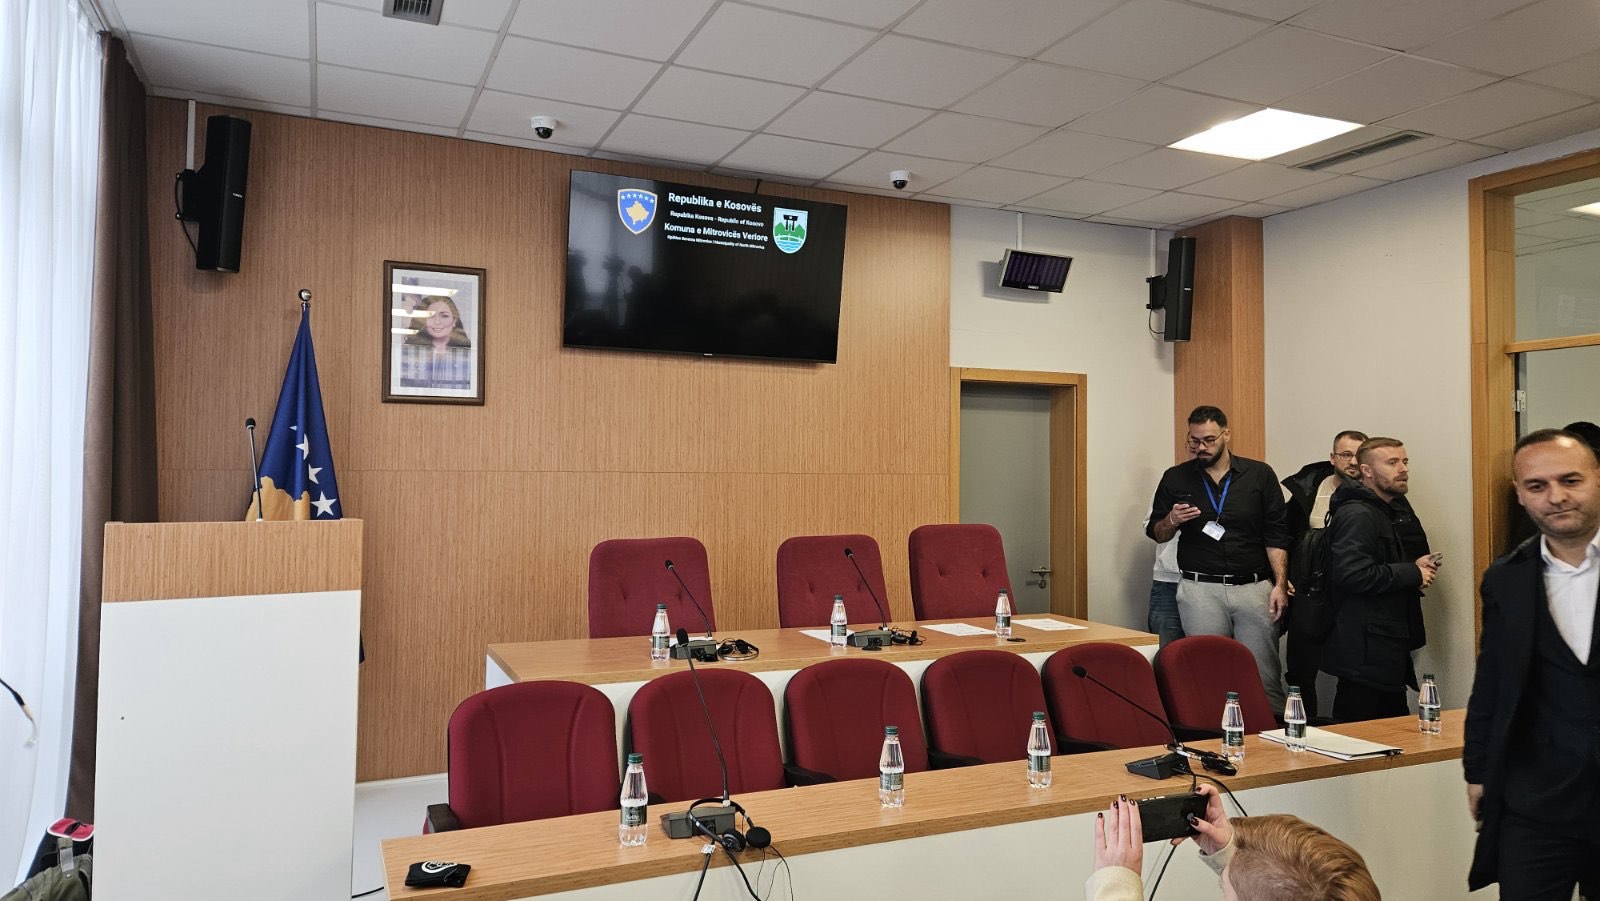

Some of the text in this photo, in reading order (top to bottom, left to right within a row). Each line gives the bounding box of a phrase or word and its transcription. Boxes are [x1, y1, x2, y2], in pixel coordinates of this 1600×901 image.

[668, 192, 762, 213] Republika e Kosovës
[670, 210, 695, 219] Republika
[664, 222, 695, 234] Komuna
[703, 227, 741, 239] Mitrovicës
[742, 231, 768, 242] Veriore
